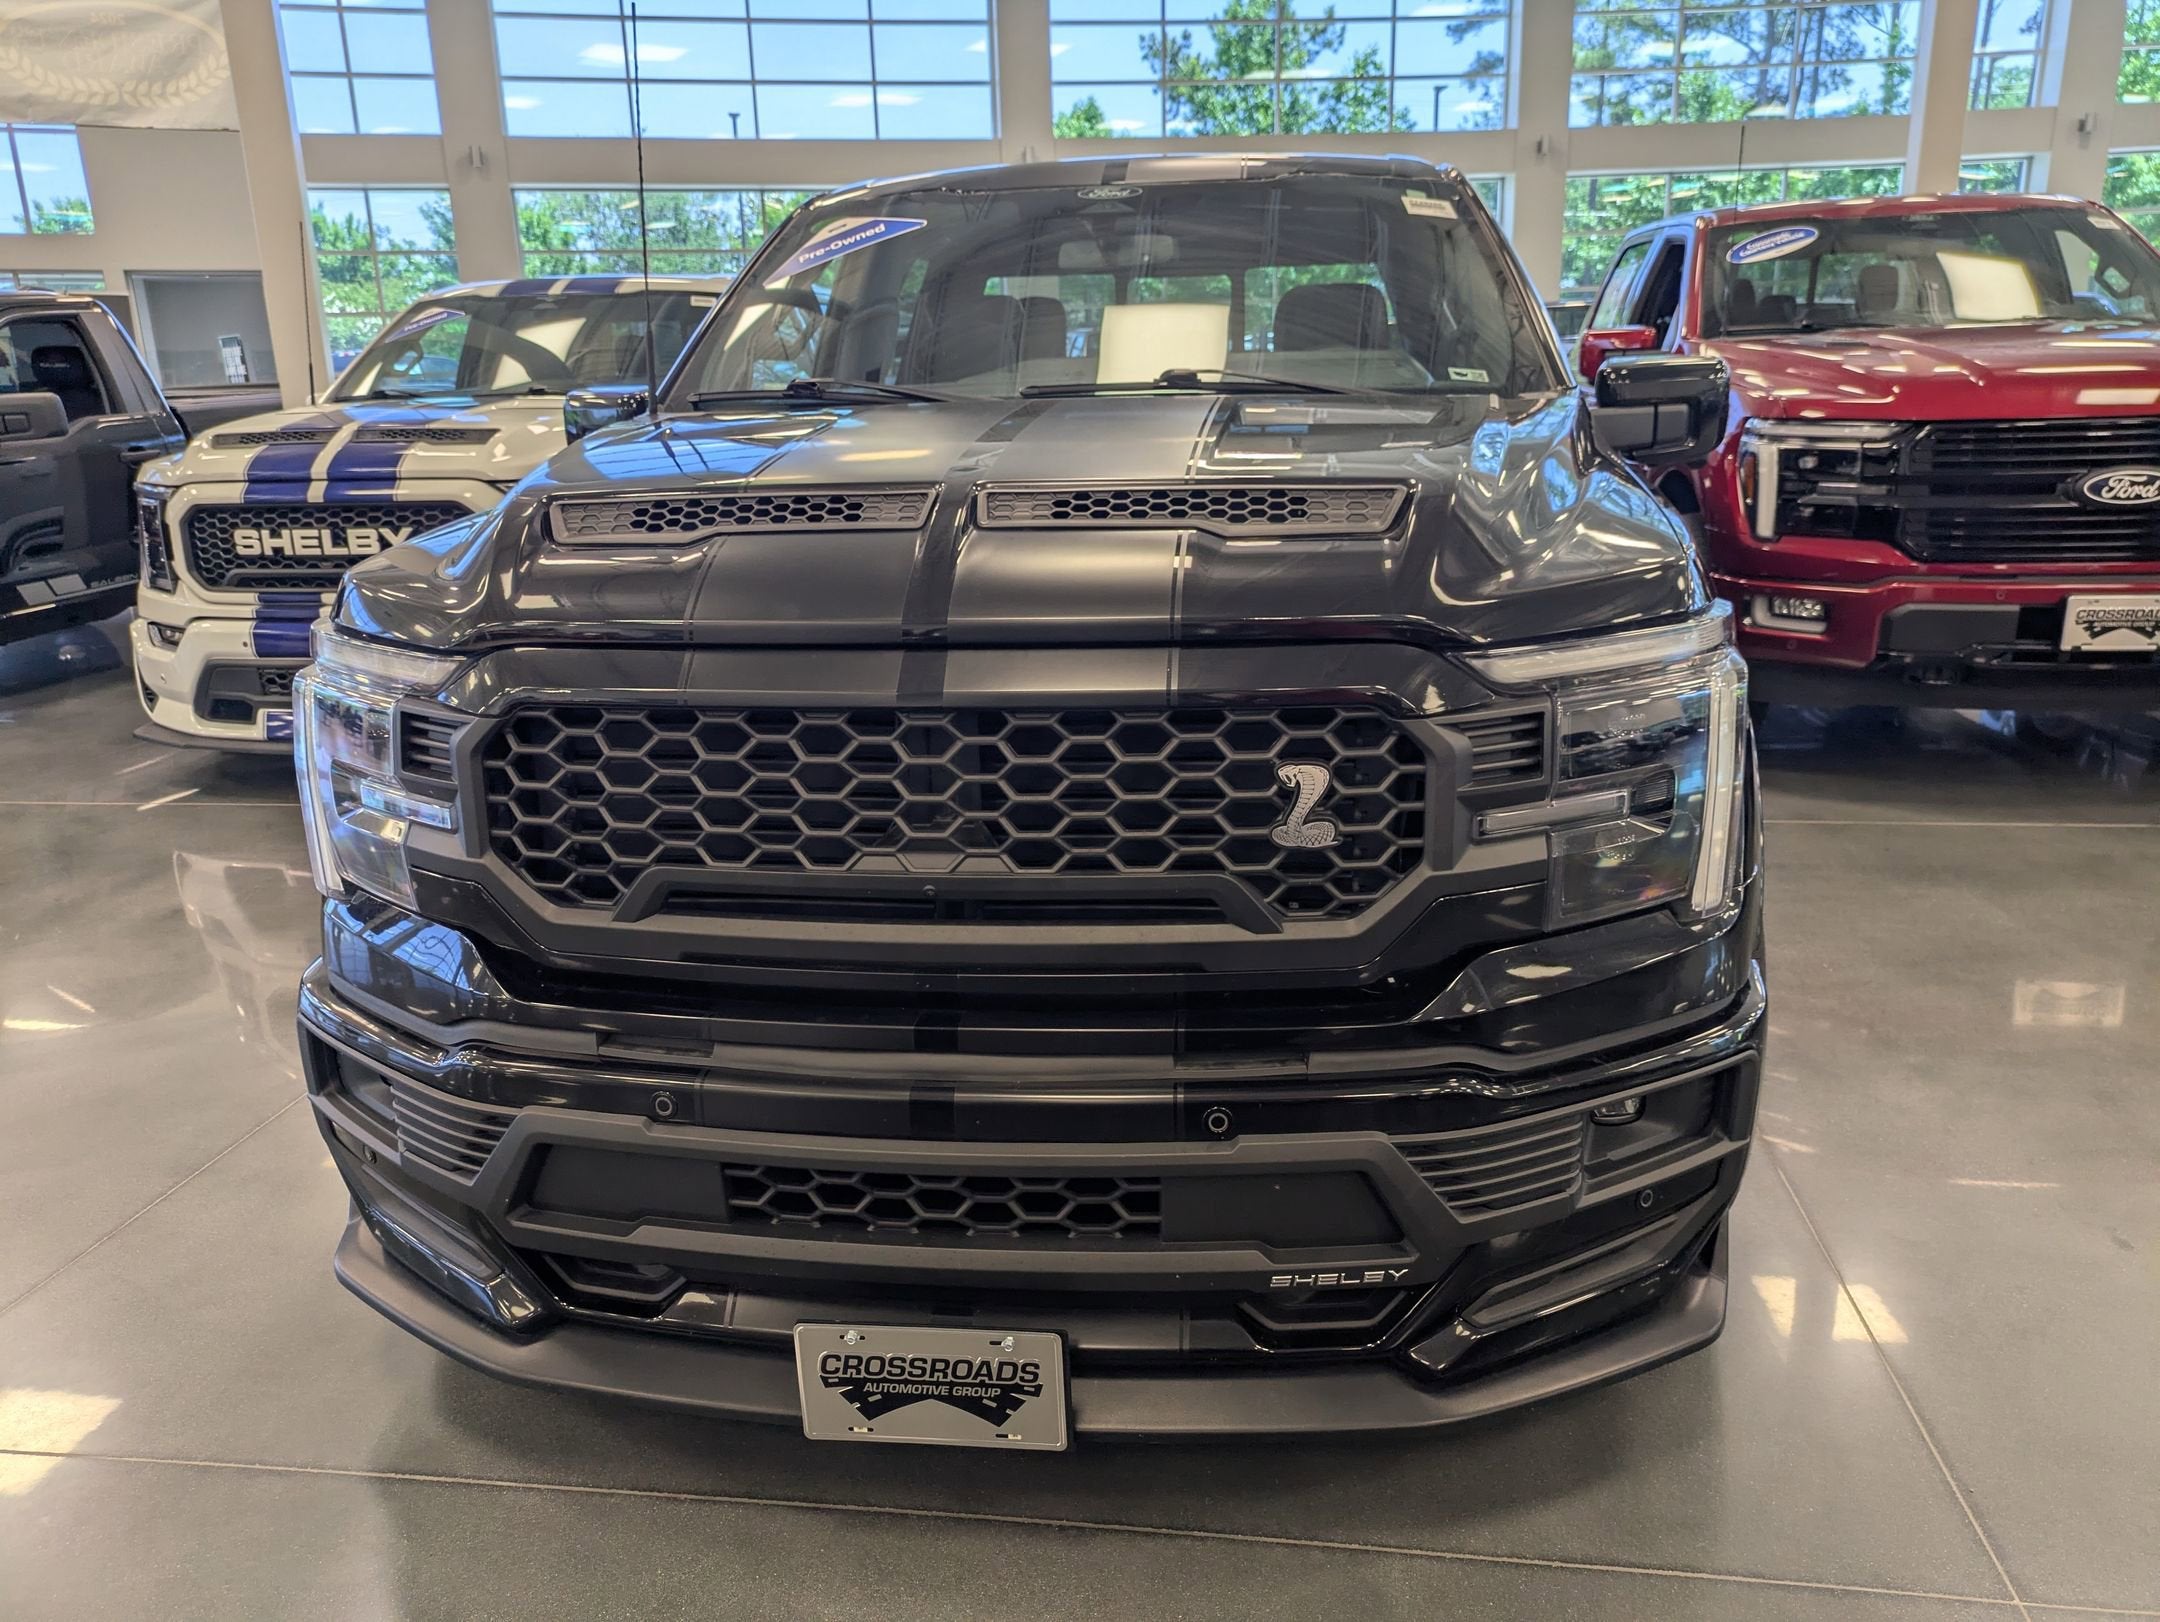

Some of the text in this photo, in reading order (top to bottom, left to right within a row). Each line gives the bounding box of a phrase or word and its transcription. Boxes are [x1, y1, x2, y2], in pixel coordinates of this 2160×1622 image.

[799, 223, 886, 263] Pre-Owned
[2101, 475, 2160, 499] Ford
[233, 527, 413, 556] SHELBY
[1270, 1269, 1409, 1287] SHELBY
[819, 1353, 1042, 1384] CROSSROADS
[863, 1382, 1001, 1399] AUTOMOTIVE GROUP
